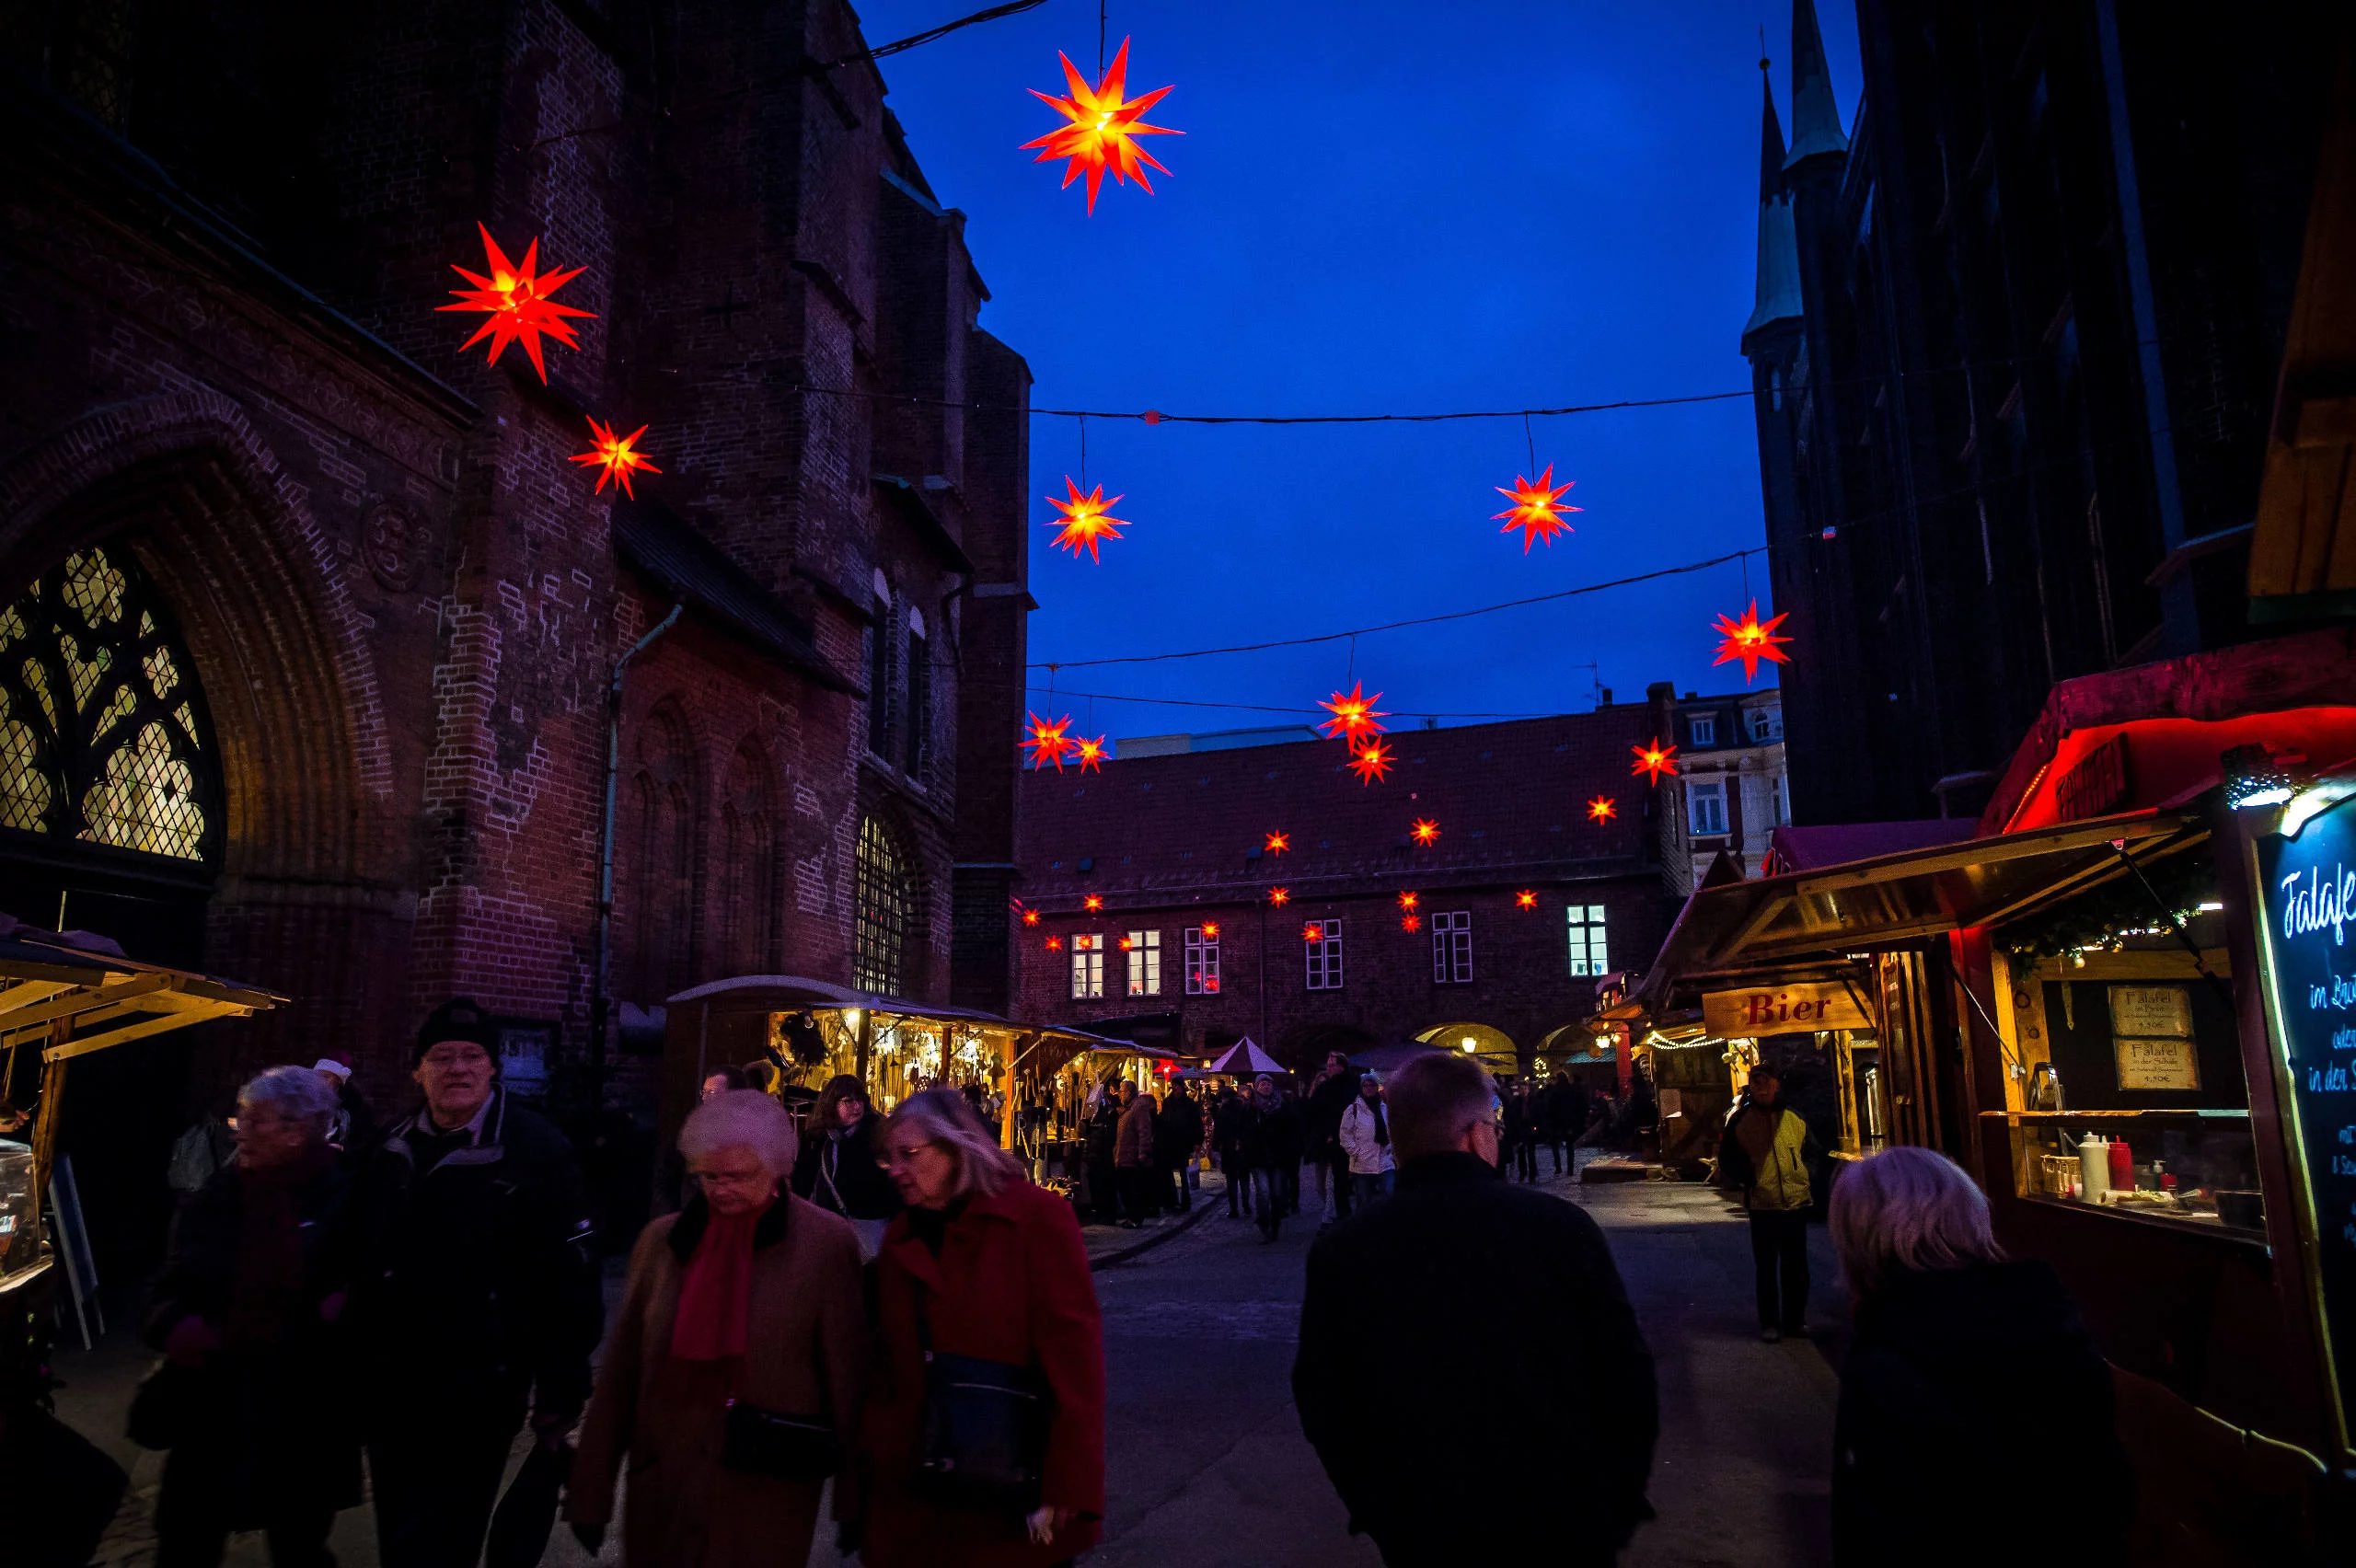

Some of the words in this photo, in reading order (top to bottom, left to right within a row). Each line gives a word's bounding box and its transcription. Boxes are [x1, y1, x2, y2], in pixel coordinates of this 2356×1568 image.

[2127, 991, 2171, 1005] Falafel
[1748, 993, 1831, 1025] Bier
[2131, 1043, 2177, 1057] Falafel
